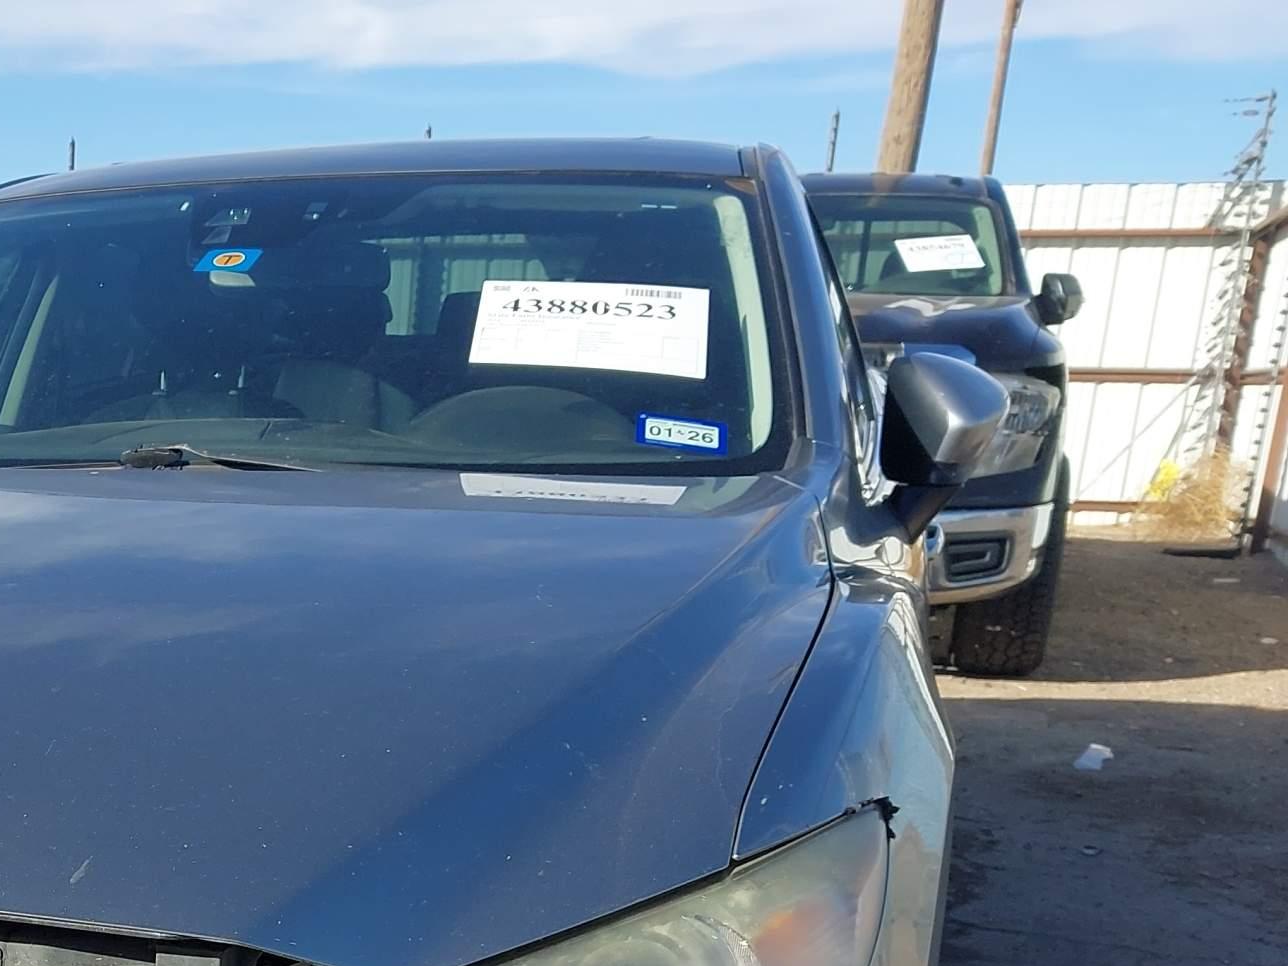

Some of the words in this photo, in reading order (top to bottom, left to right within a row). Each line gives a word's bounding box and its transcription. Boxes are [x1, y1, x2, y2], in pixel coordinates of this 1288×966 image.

[502, 298, 677, 321] 43880523
[649, 425, 673, 438] 01
[687, 430, 715, 443] 26
